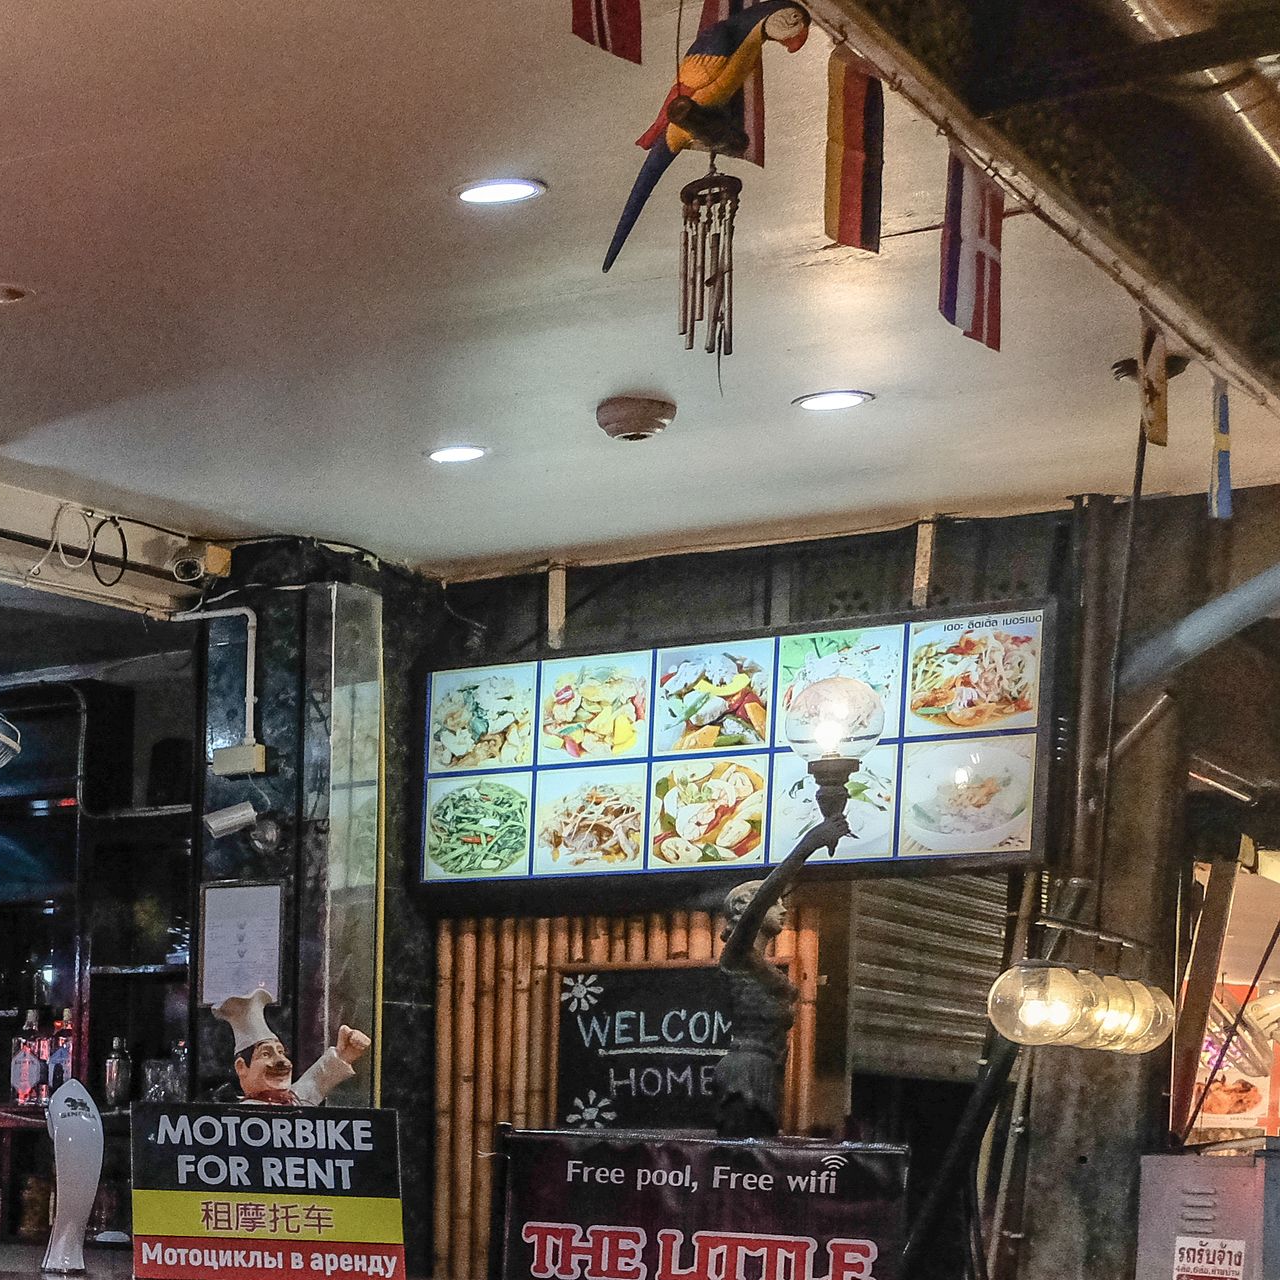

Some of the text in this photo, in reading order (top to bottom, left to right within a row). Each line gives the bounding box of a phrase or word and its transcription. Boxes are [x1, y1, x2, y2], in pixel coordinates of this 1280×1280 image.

[577, 1008, 734, 1048] WELCOM
[608, 1064, 716, 1098] HOME
[156, 1114, 374, 1152] MOTORBIKE
[177, 1154, 355, 1190] FOR RENT
[567, 1160, 837, 1194] Free pool, Free wifi
[200, 1199, 336, 1236] 租摩托车
[141, 1242, 398, 1280] Мотоциклы в аренду
[1178, 1240, 1243, 1267] รถรับจ้าง
